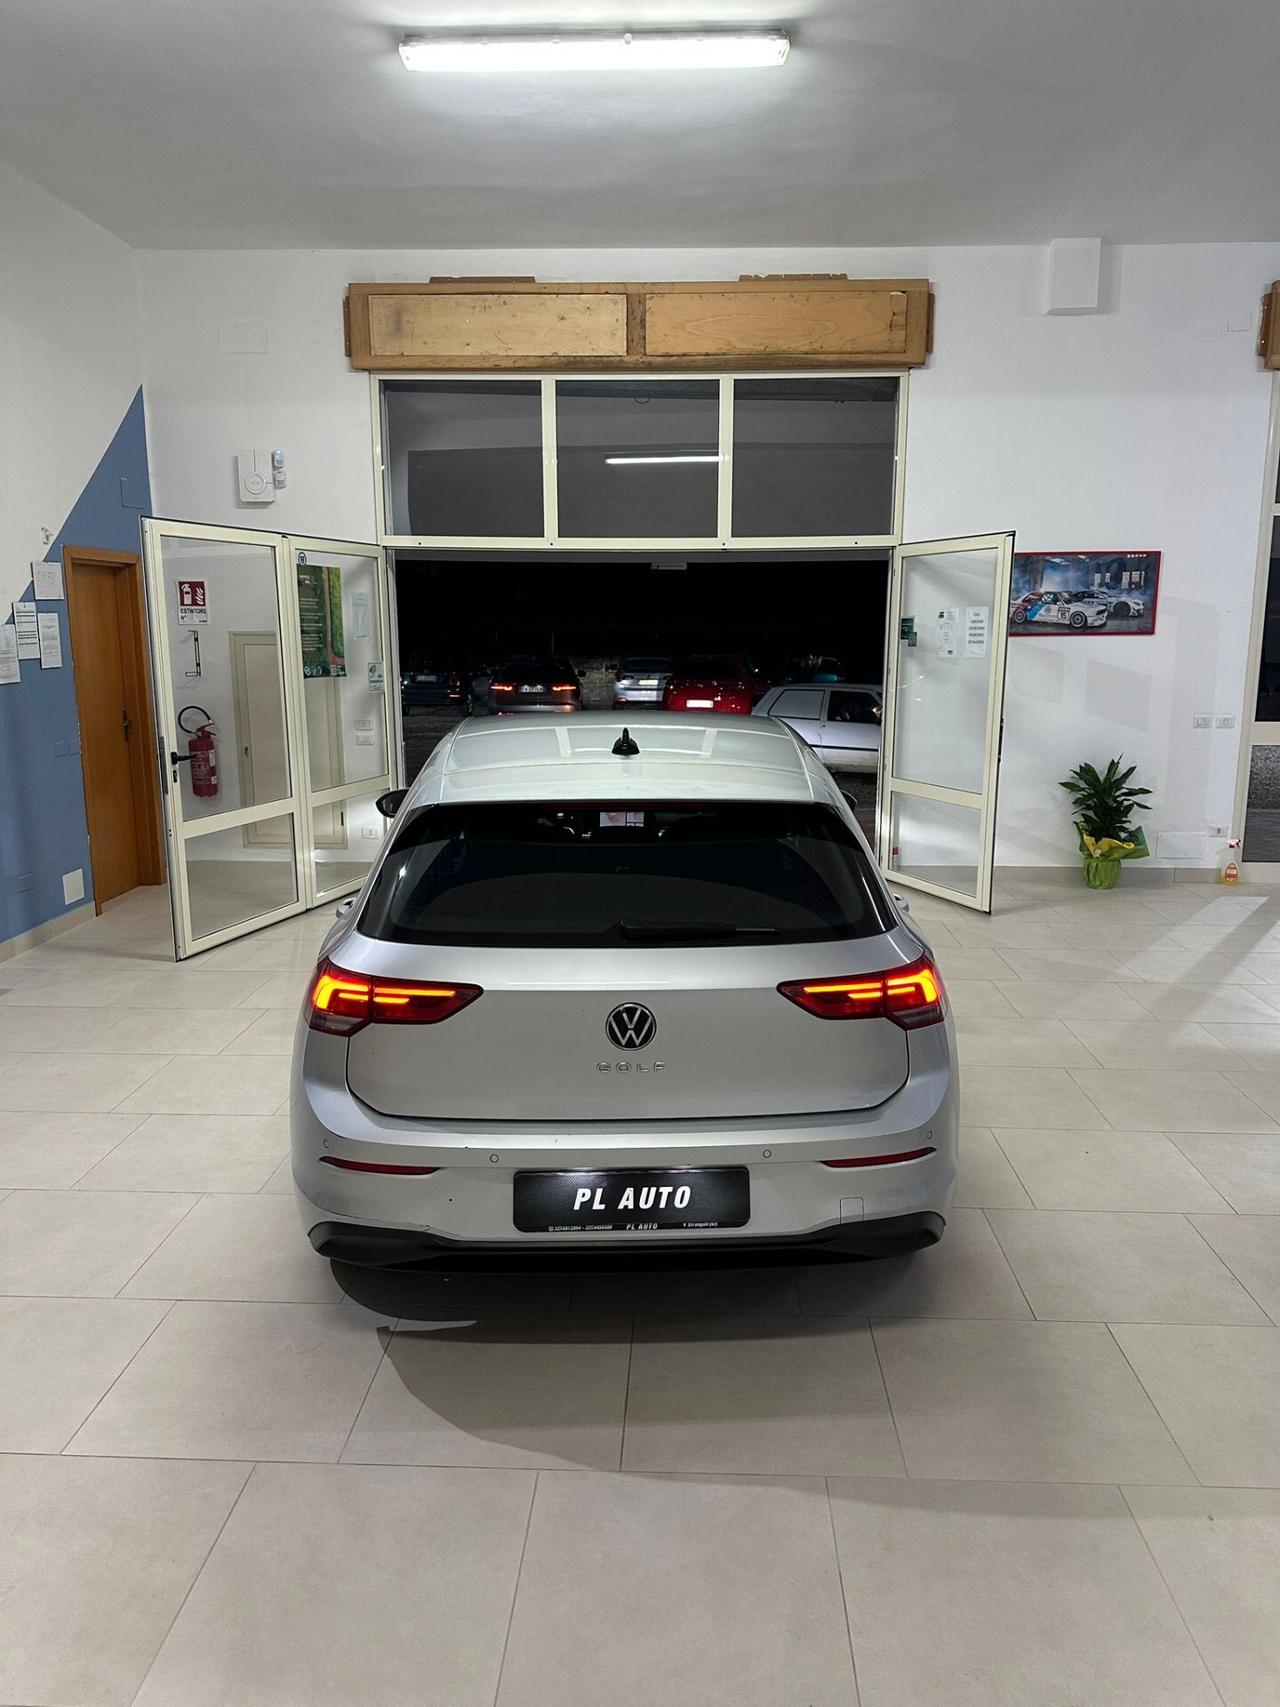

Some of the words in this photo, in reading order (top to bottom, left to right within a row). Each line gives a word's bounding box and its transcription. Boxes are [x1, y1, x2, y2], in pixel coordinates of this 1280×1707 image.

[596, 1061, 665, 1073] GOLF
[573, 1188, 606, 1210] PL
[617, 1186, 691, 1209] AUTO
[638, 1222, 658, 1230] AUTO
